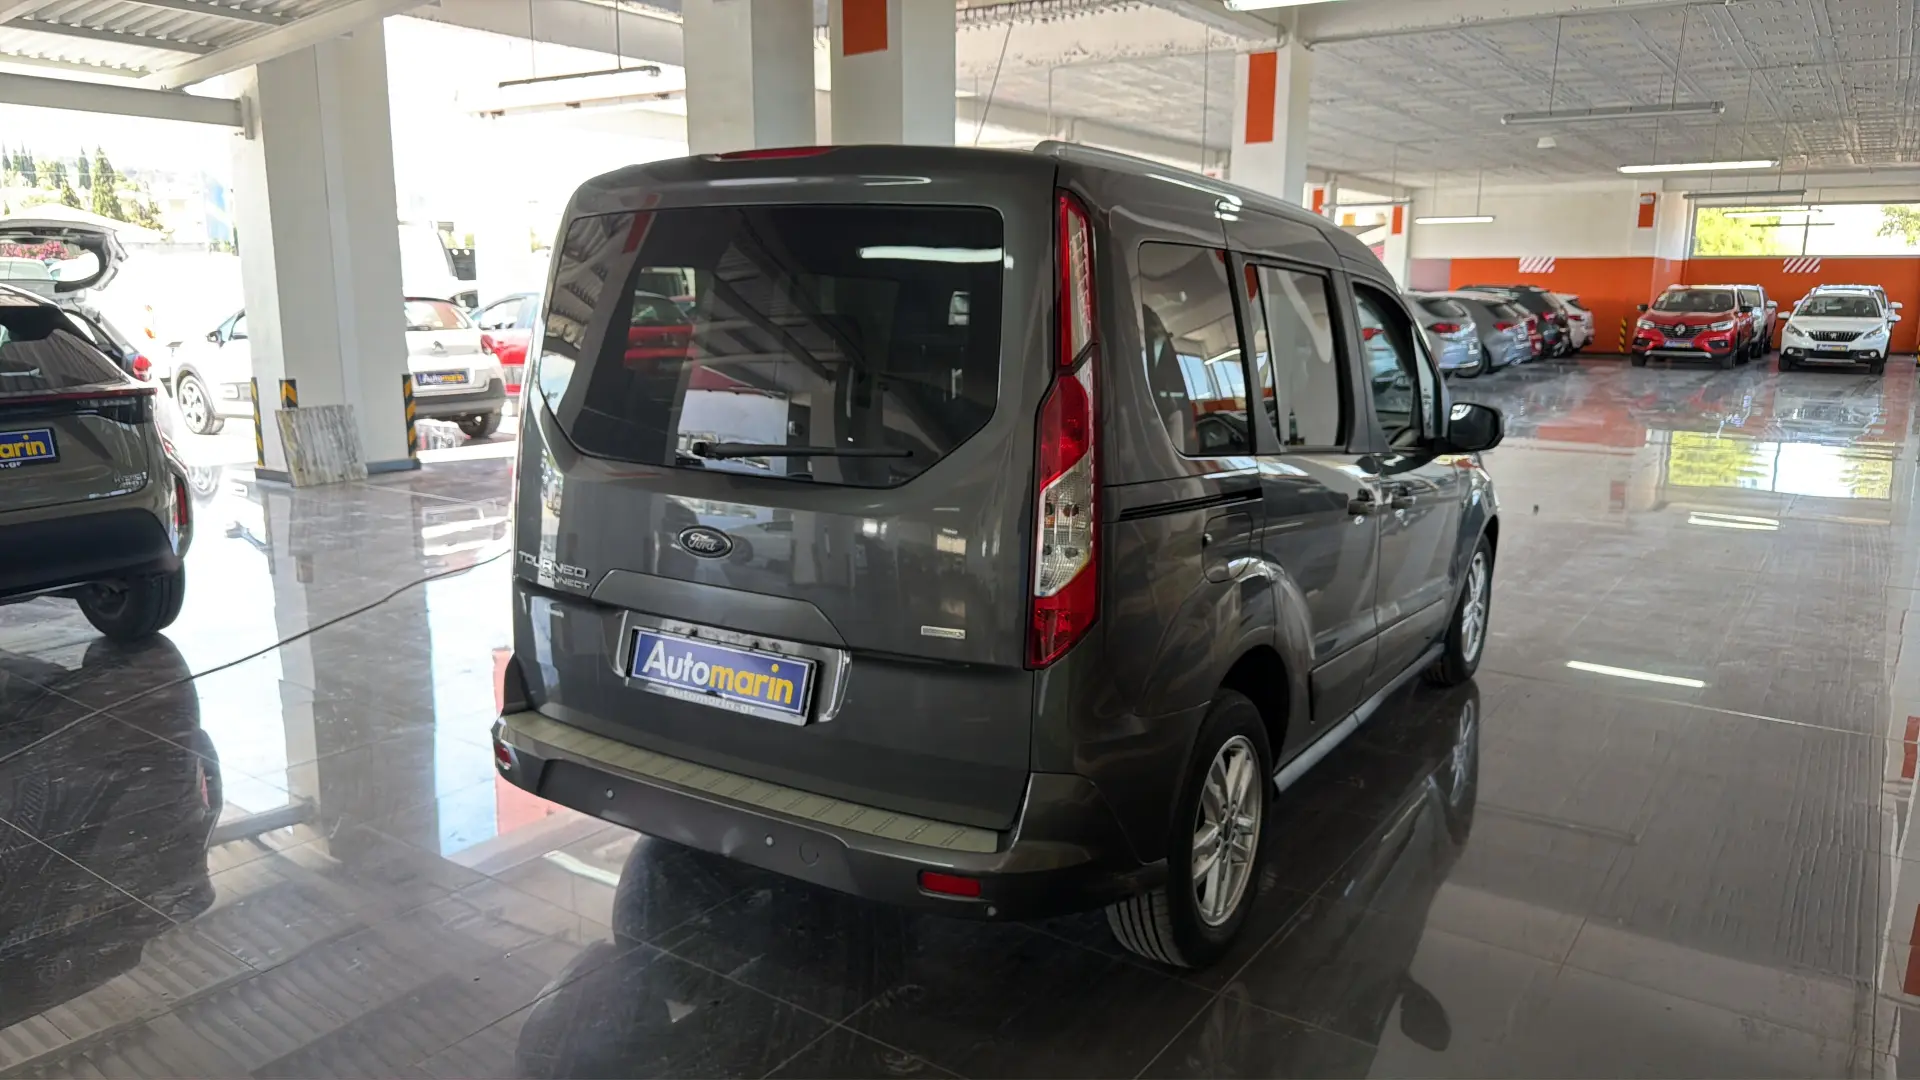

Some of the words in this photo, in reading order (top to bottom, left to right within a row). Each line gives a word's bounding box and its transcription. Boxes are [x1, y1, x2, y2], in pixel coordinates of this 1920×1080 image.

[688, 532, 717, 551] Ford
[518, 549, 587, 578] TOURNEO
[642, 639, 794, 705] Automarin
[666, 686, 756, 715] Automarin.gr
